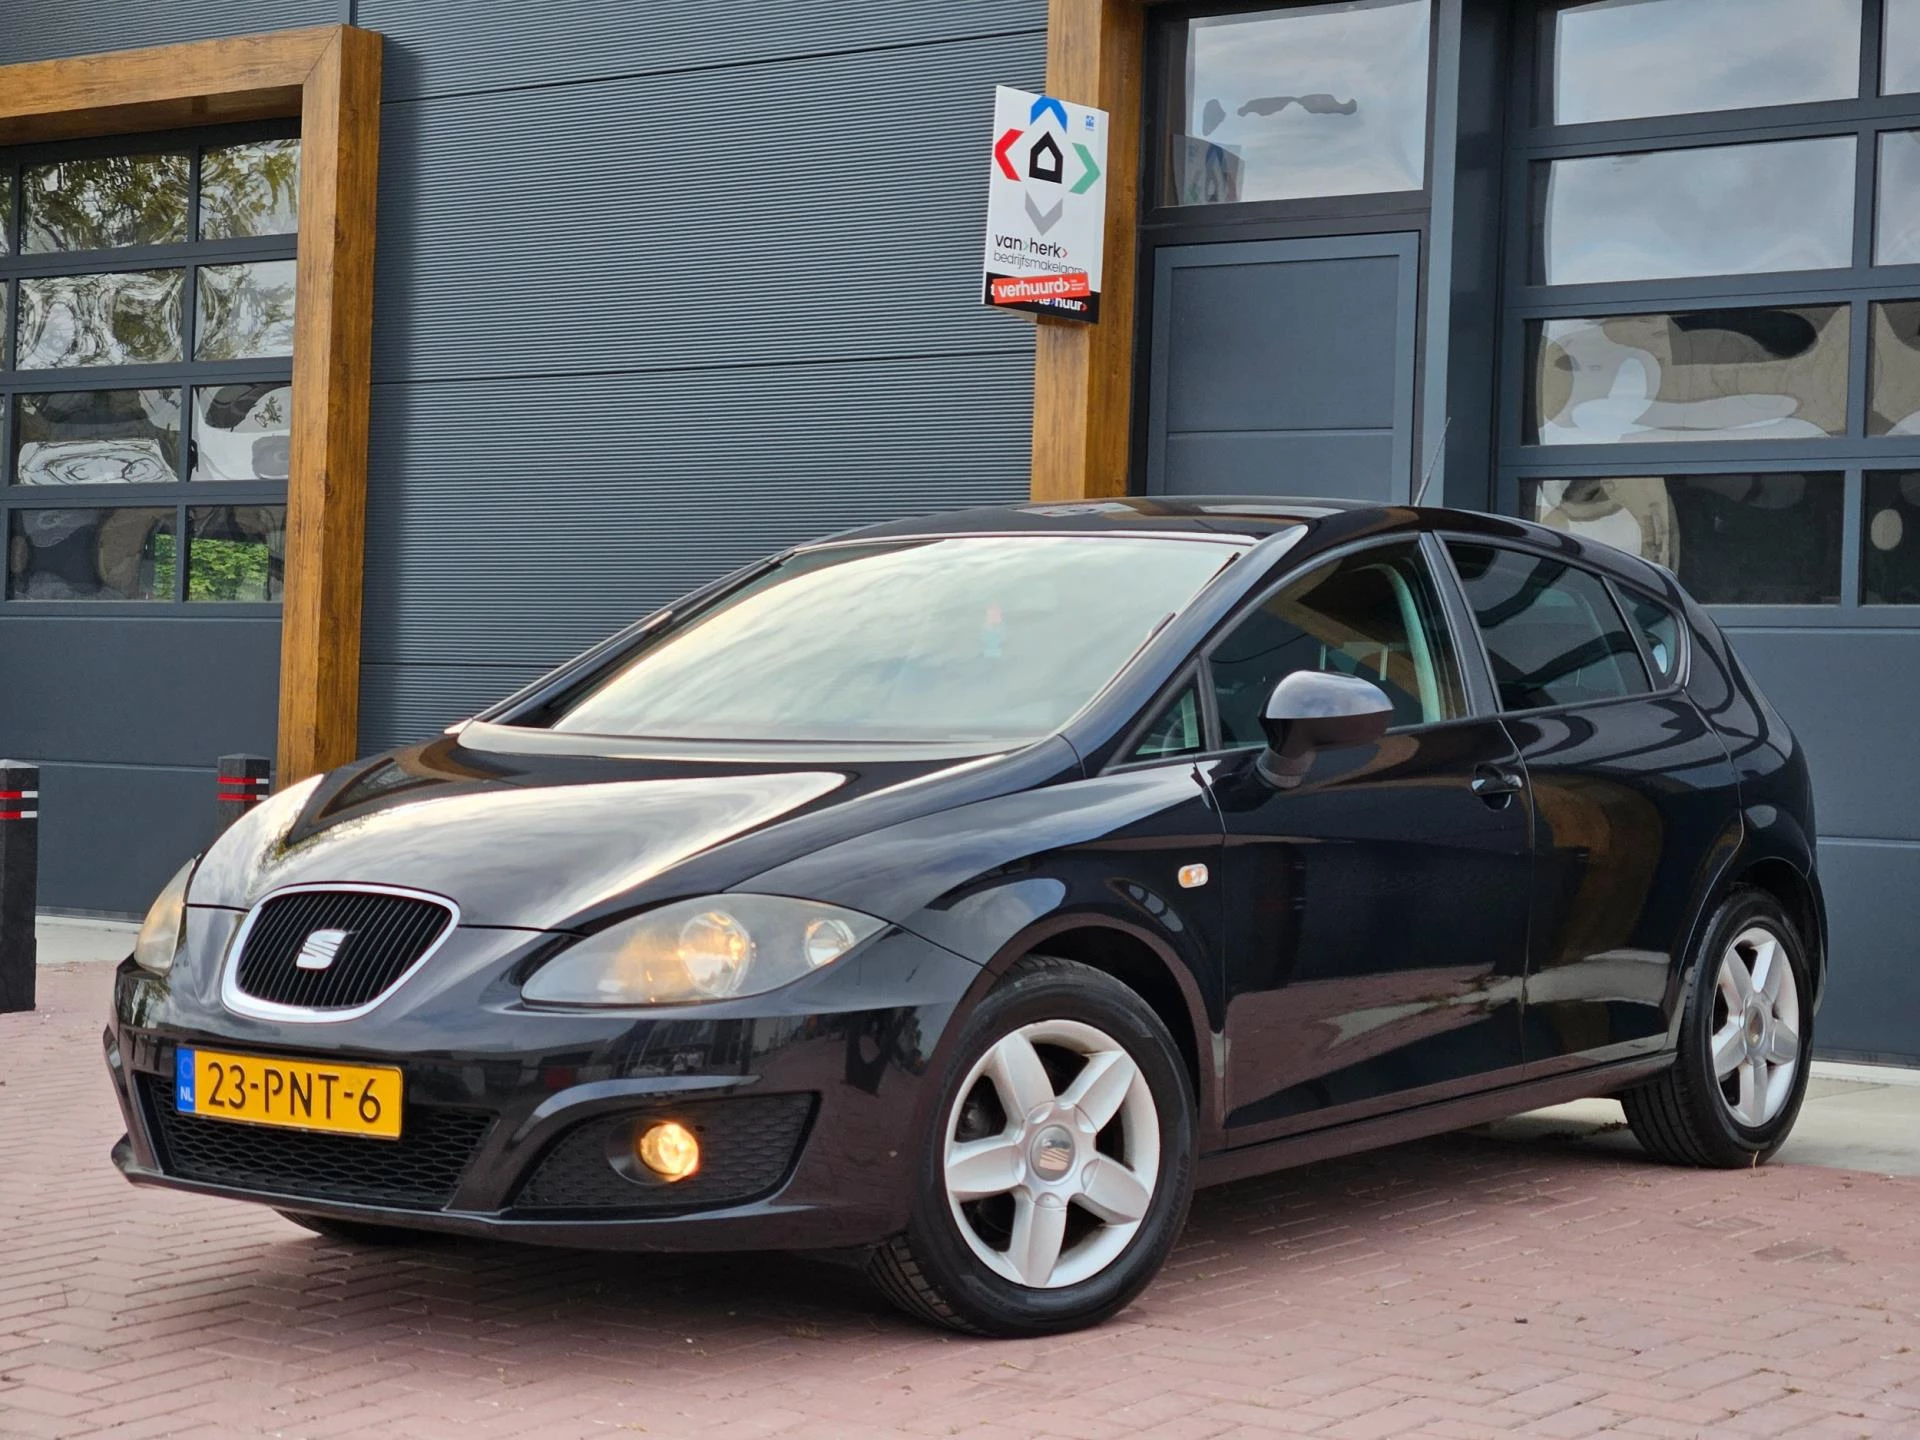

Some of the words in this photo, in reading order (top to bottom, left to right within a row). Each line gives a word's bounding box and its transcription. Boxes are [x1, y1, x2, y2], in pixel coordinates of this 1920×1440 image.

[995, 234, 1022, 251] van
[1029, 237, 1062, 259] herk
[997, 276, 1064, 298] verhuurd
[180, 1086, 193, 1103] NL
[207, 1061, 382, 1124] 23-PNT-6
